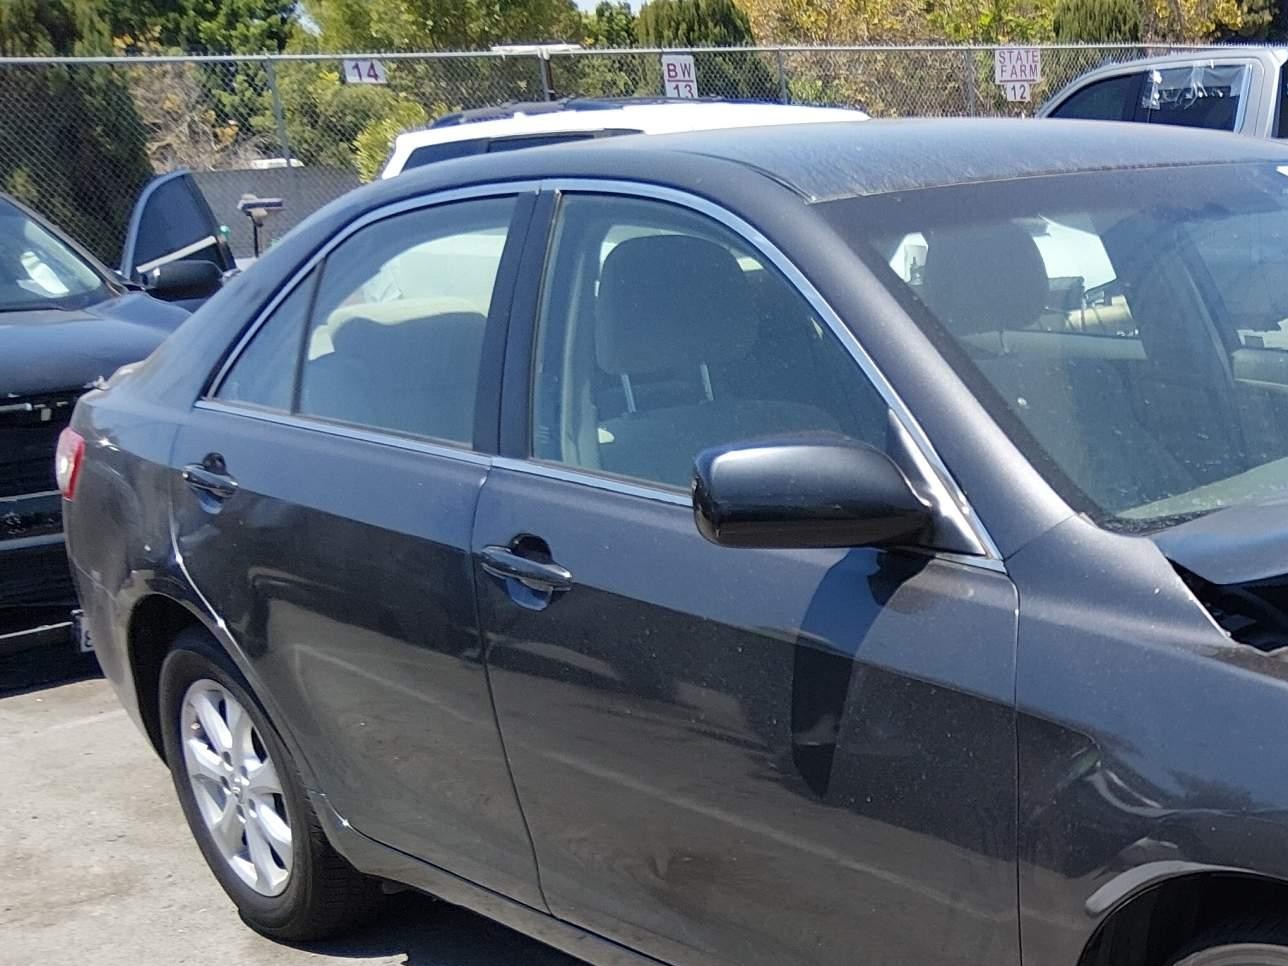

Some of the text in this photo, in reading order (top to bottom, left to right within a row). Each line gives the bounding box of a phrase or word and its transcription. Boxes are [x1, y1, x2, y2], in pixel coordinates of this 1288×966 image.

[998, 50, 1039, 65] STATE
[352, 61, 378, 81] 14
[666, 63, 692, 79] BW
[1001, 64, 1038, 79] FARM
[672, 83, 695, 98] 13
[1011, 84, 1027, 100] 12
